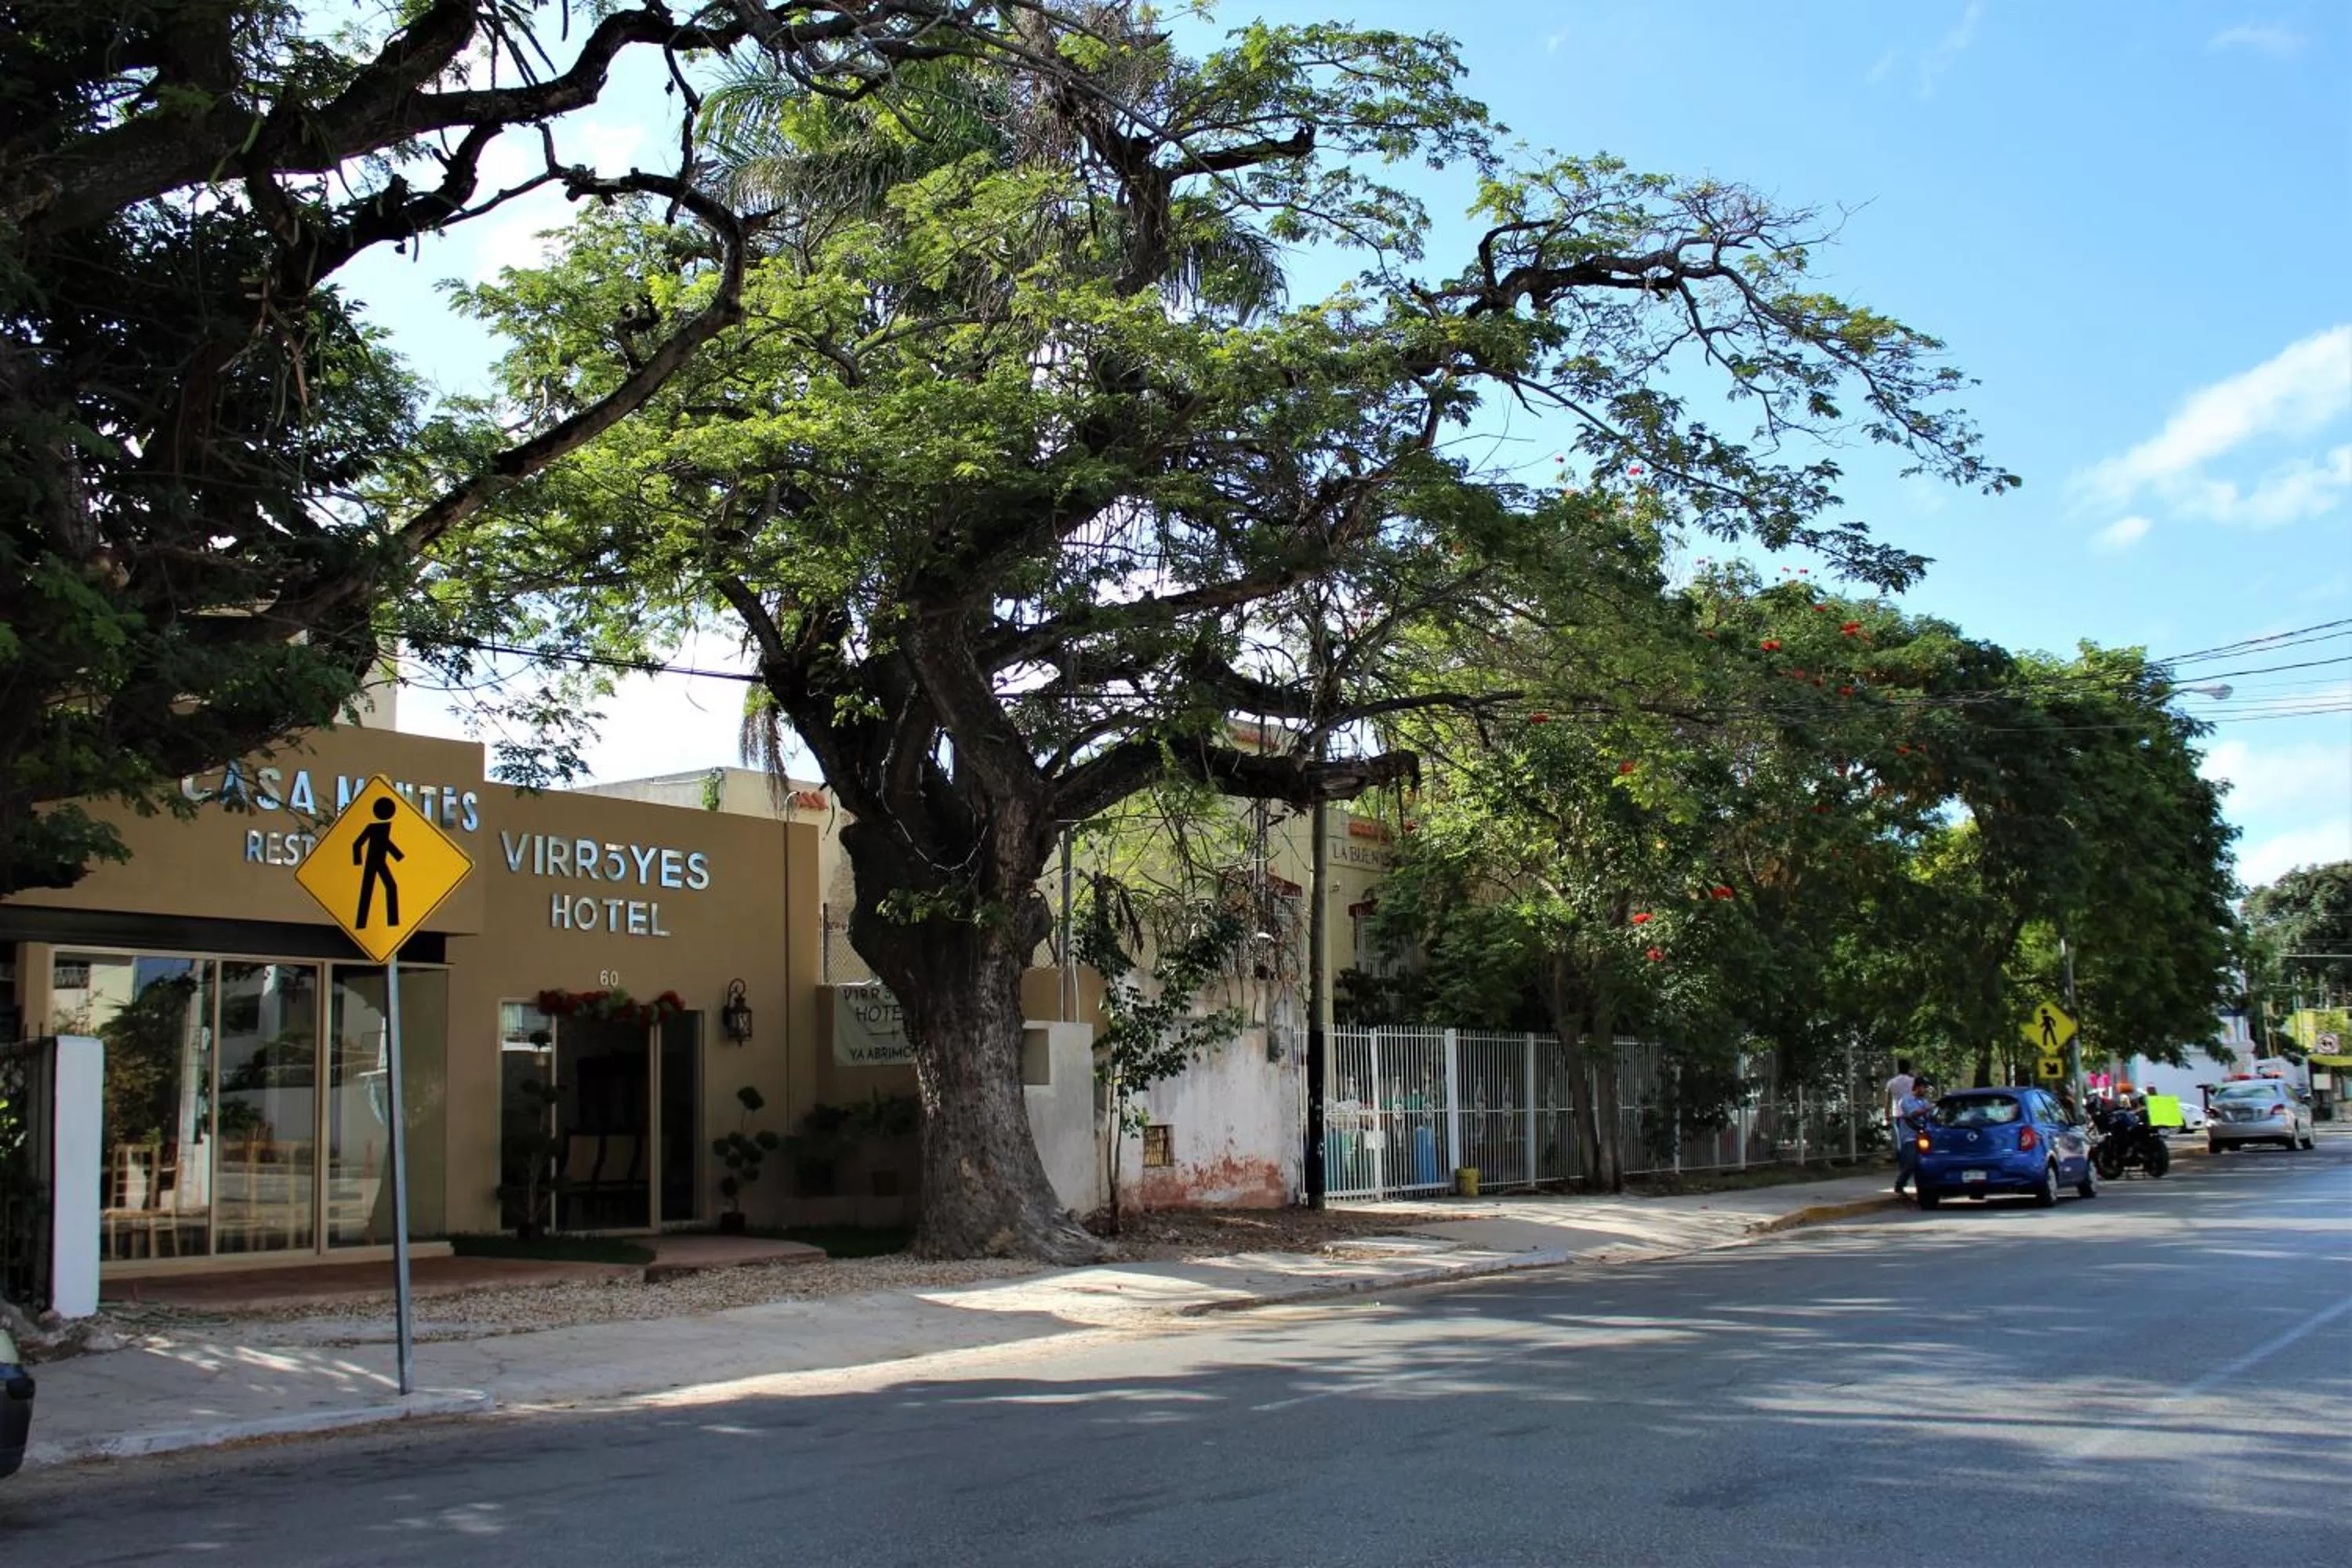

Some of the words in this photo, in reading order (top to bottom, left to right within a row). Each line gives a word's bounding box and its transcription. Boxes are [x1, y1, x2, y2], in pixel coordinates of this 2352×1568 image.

[550, 892, 670, 937] HOTEL
[600, 969, 619, 986] 60
[855, 1004, 904, 1023] HOTE
[849, 1047, 864, 1061] YA
[867, 1045, 912, 1060] ABRIMO
